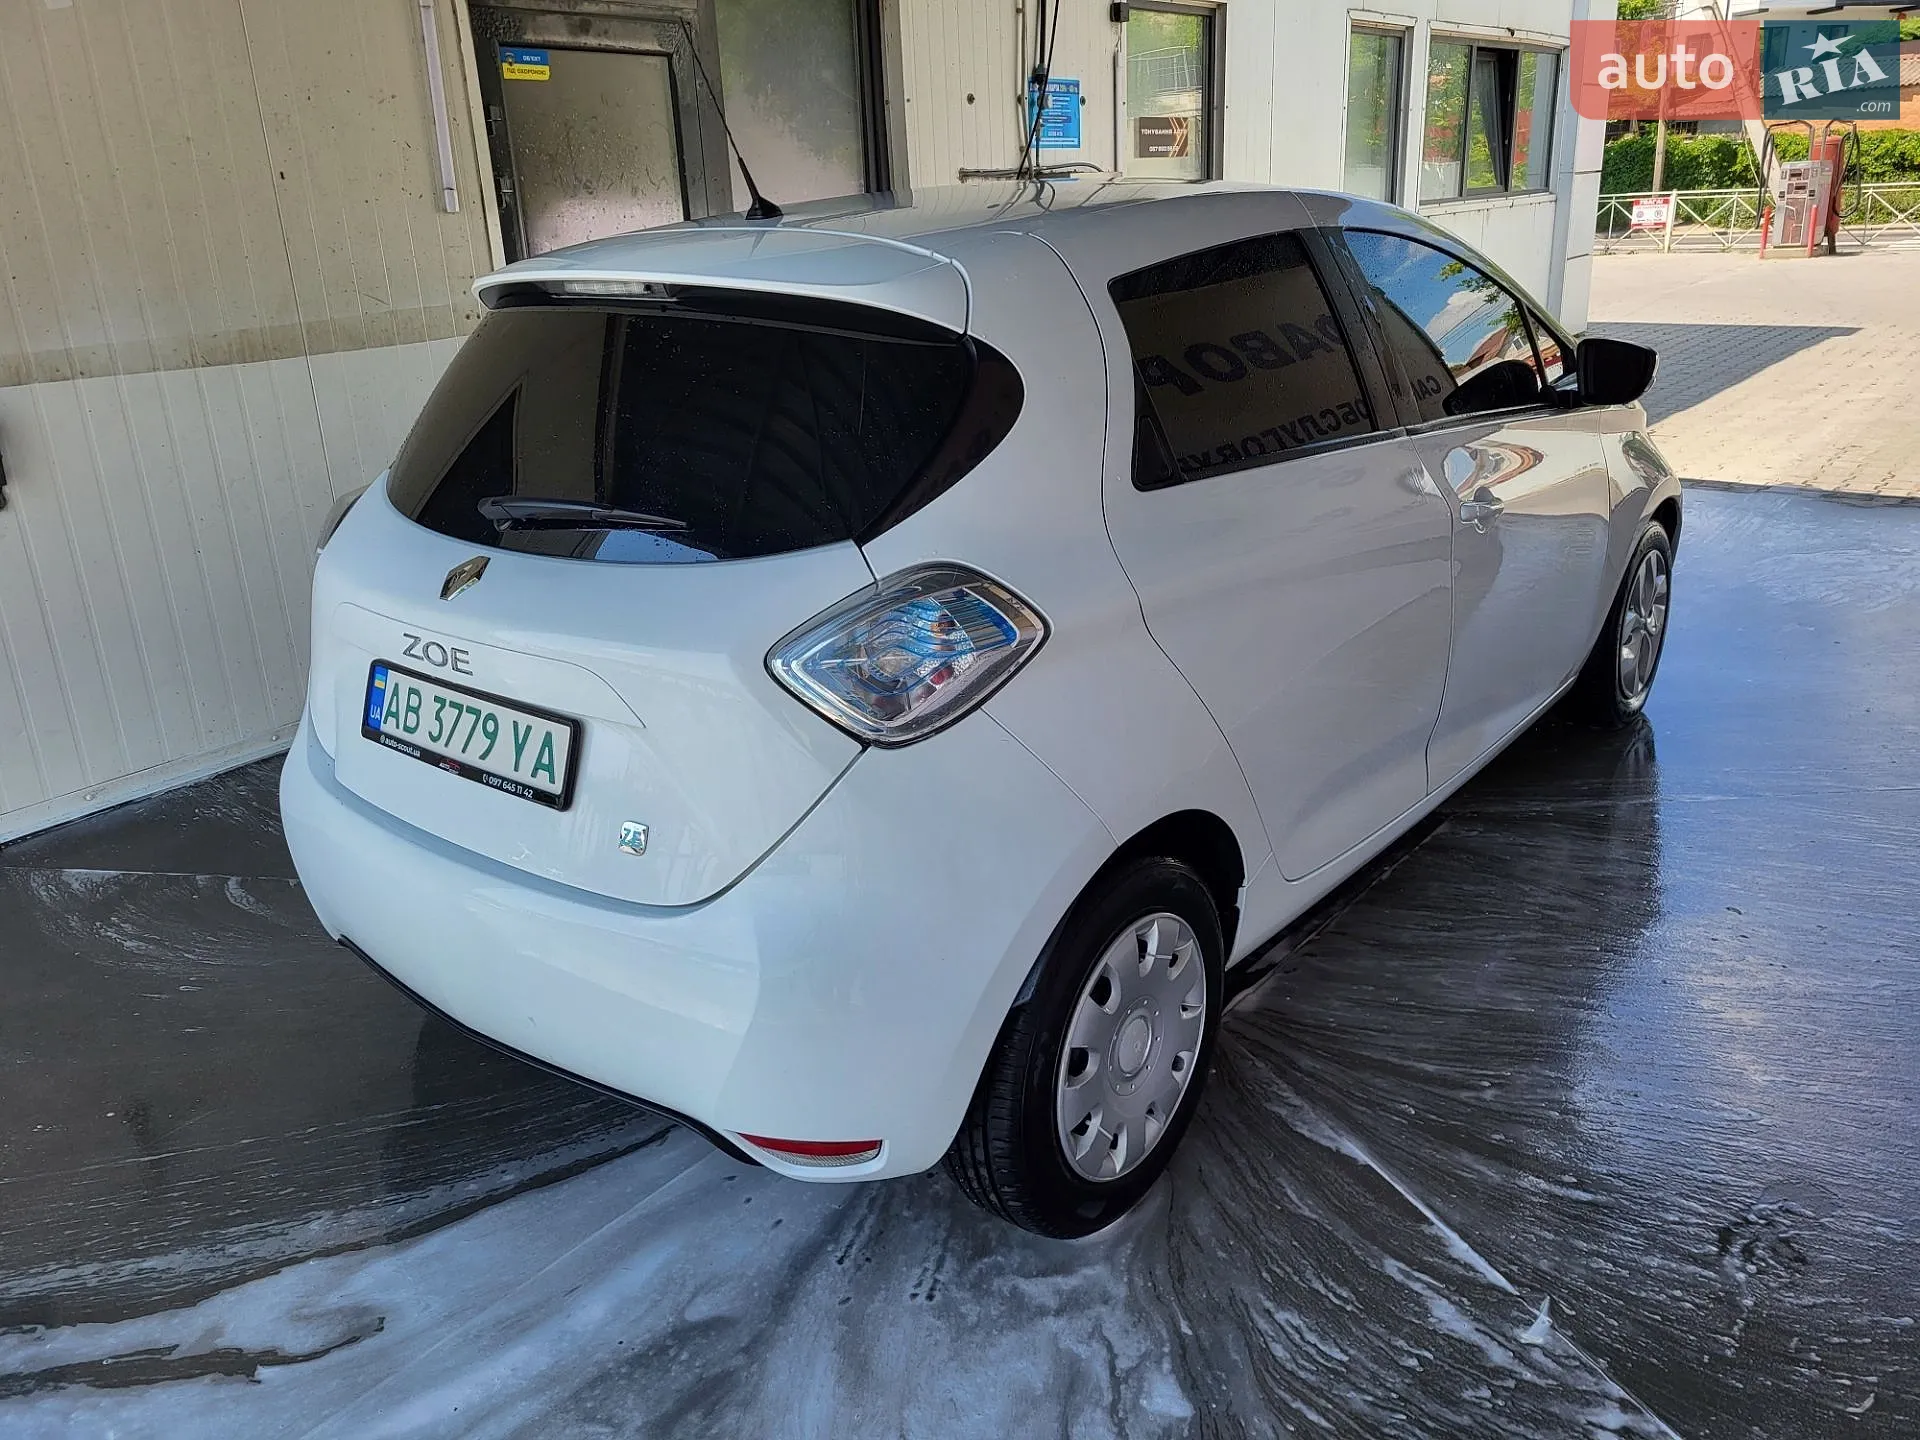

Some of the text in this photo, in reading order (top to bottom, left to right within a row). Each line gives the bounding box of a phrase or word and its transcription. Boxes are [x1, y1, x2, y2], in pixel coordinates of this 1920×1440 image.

[402, 633, 474, 676] ZOE
[370, 704, 381, 721] UA
[383, 682, 556, 784] AB 3779 YA
[384, 737, 421, 757] auto-scout.ua
[488, 776, 502, 787] 097
[502, 781, 517, 792] 645
[523, 788, 534, 799] 42
